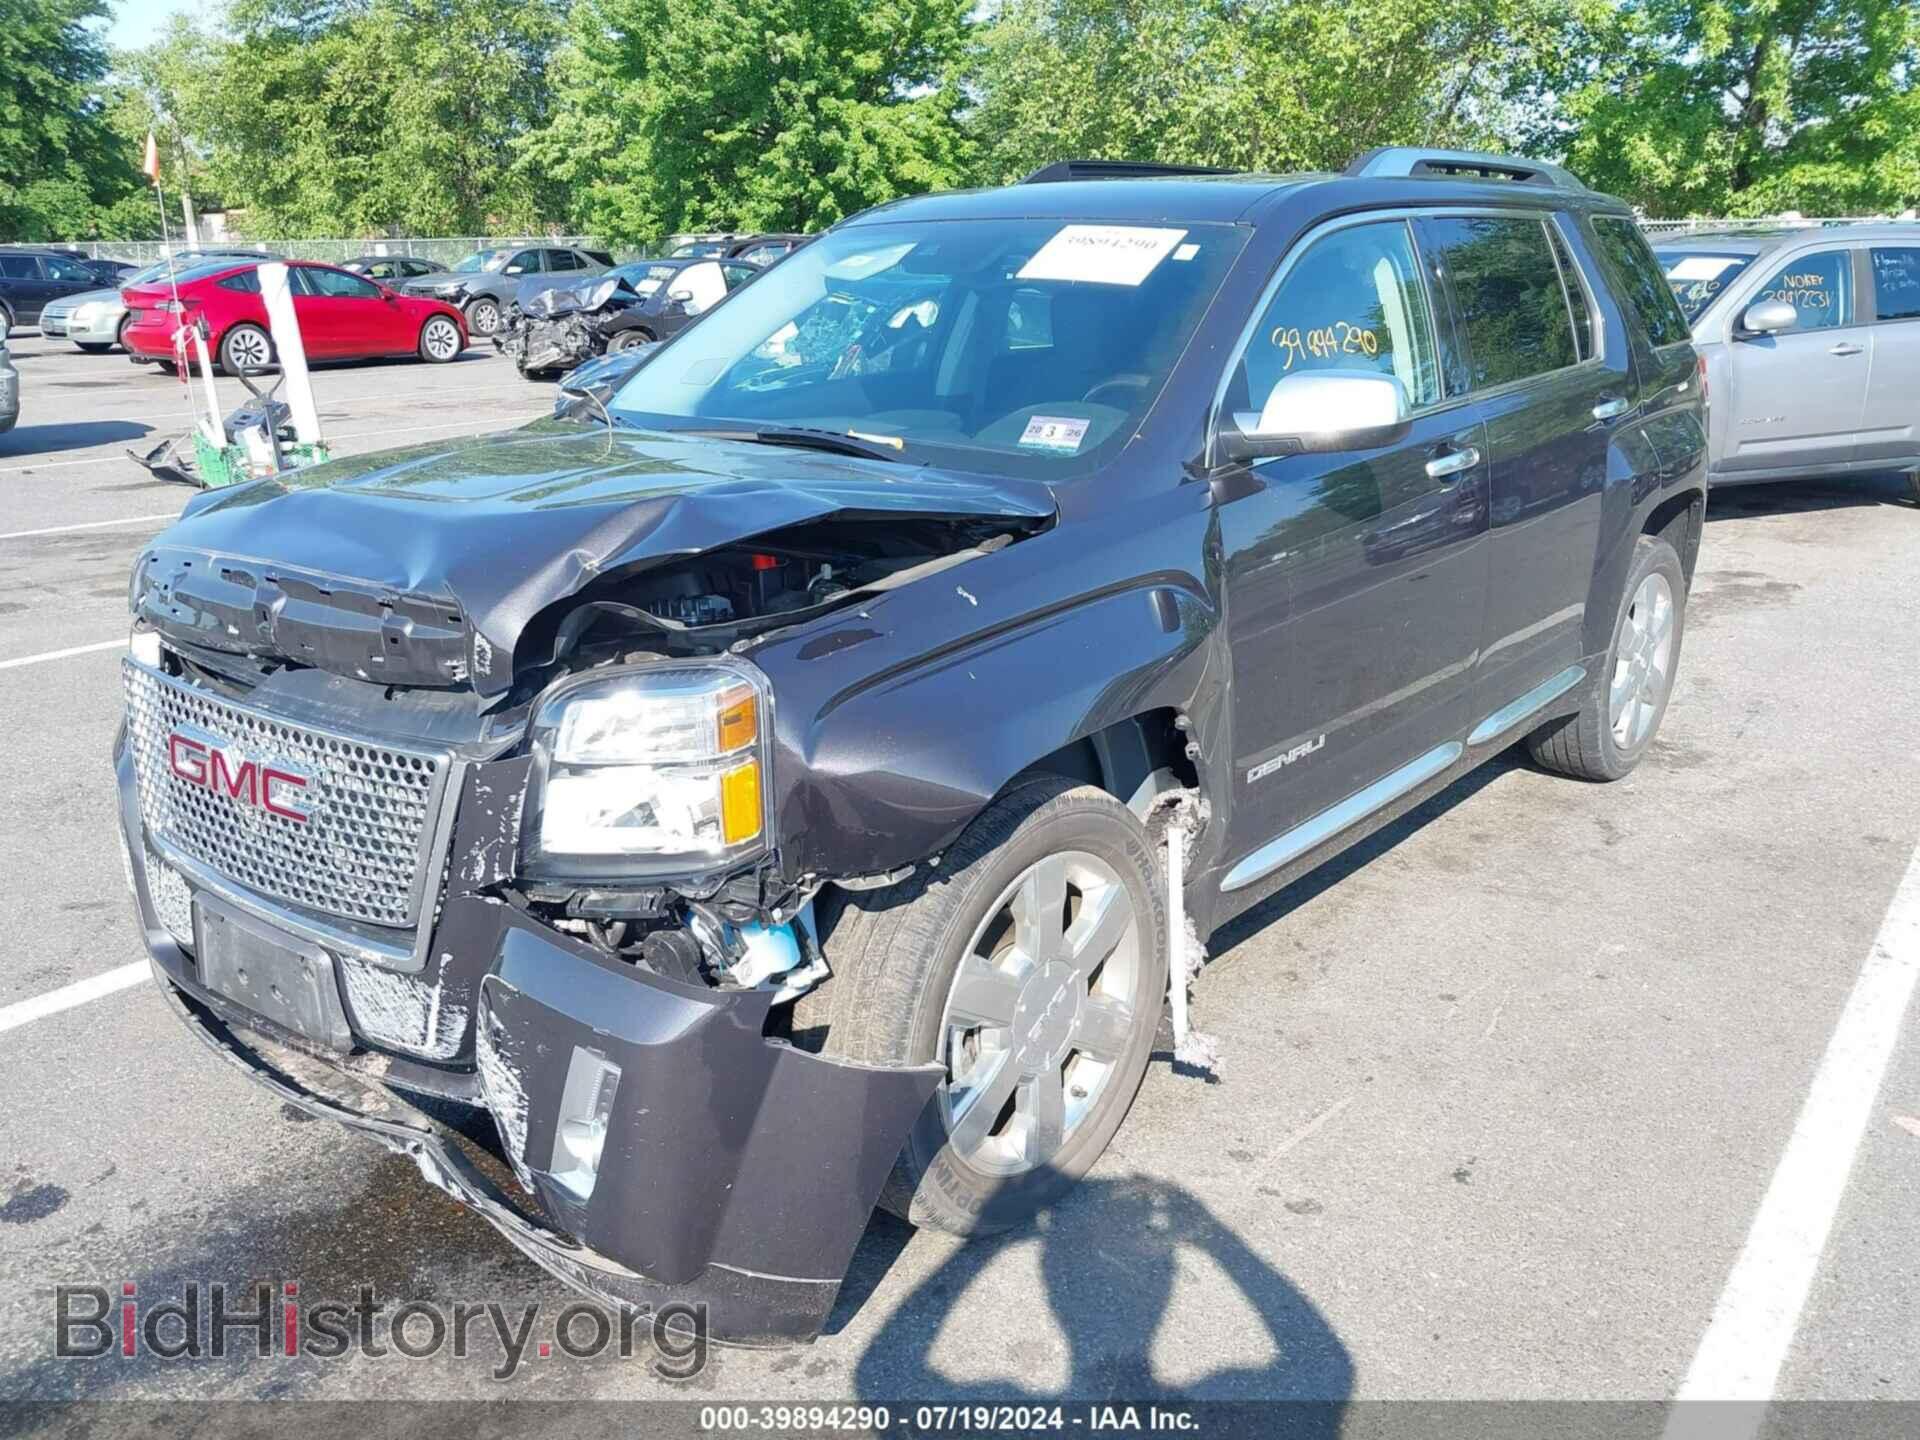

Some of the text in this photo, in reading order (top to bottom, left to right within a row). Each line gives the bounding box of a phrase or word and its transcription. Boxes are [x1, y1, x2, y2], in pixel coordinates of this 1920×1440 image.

[1045, 420, 1057, 438] 3
[170, 734, 308, 823] GMC
[1246, 733, 1326, 784] DENALI
